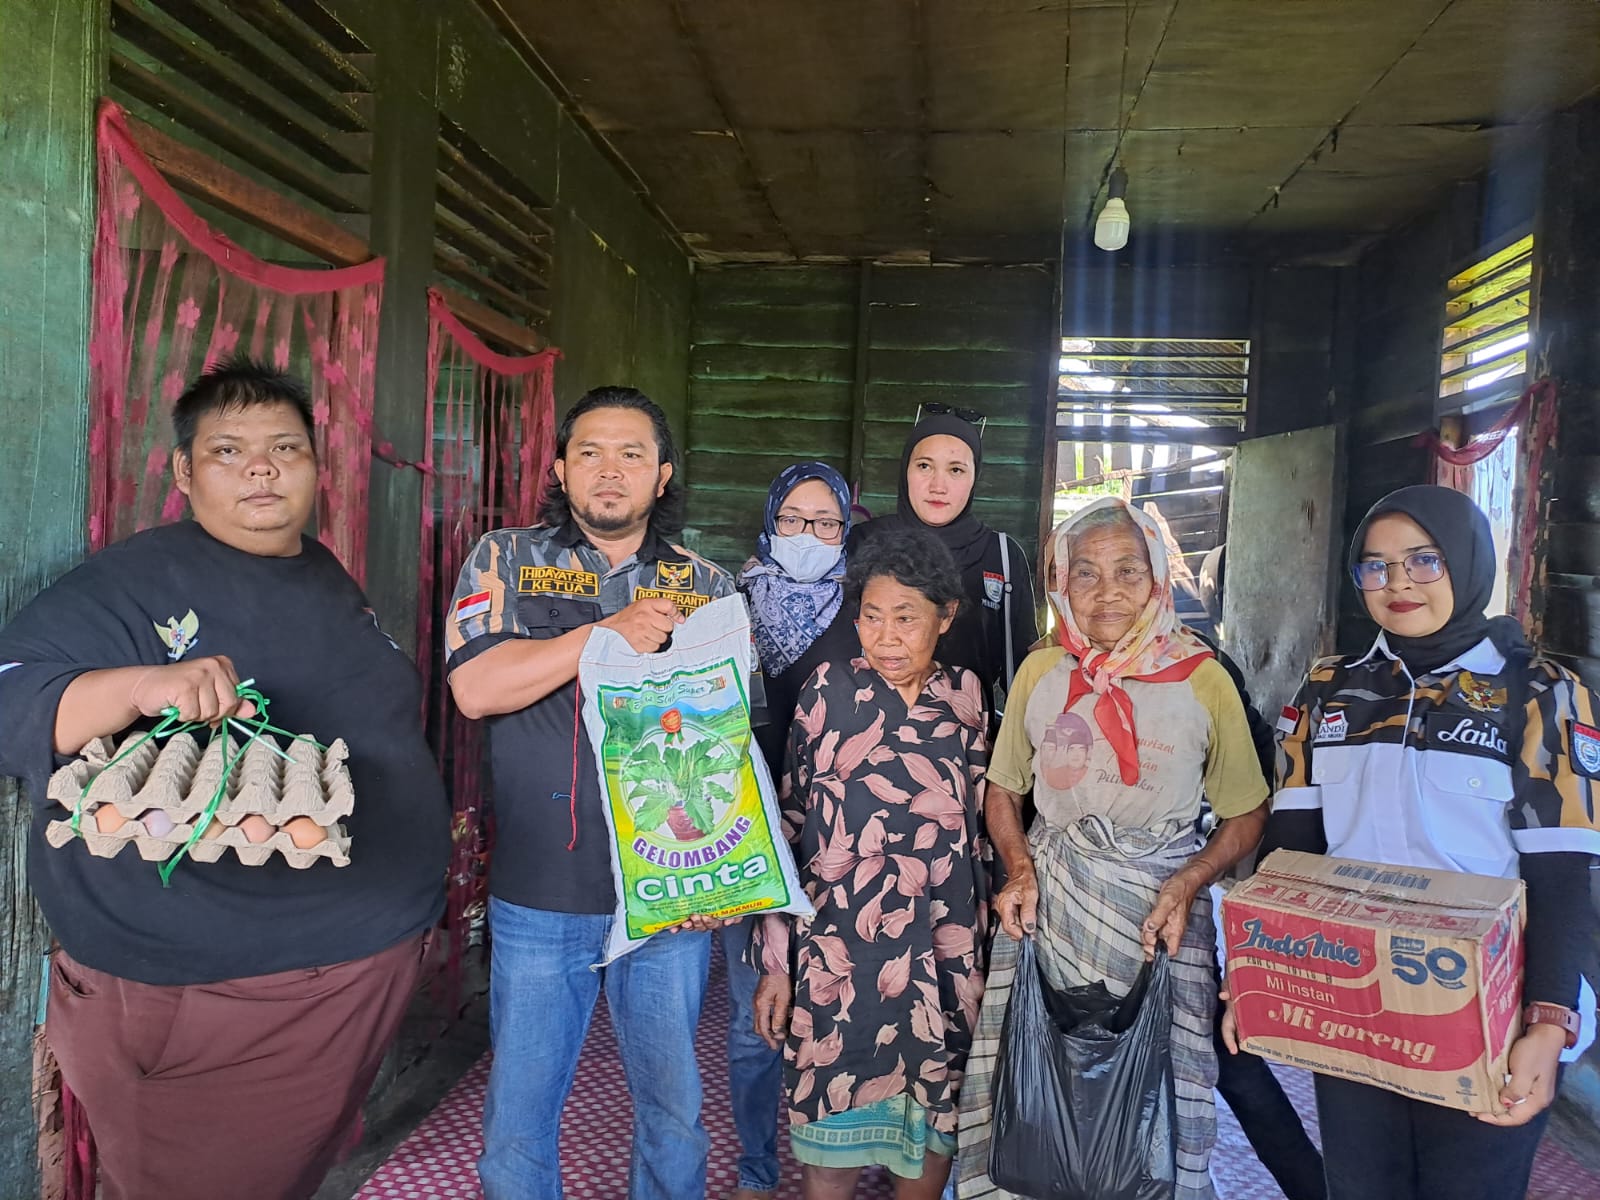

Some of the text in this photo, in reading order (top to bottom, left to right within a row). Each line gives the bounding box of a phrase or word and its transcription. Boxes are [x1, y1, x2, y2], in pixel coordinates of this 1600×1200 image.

[532, 580, 585, 593] KETUA
[633, 816, 751, 868] GELOMBANG
[1391, 947, 1468, 985] 50
[1266, 974, 1335, 1004] Mi Instan
[1268, 1002, 1436, 1064] Mi goreng
